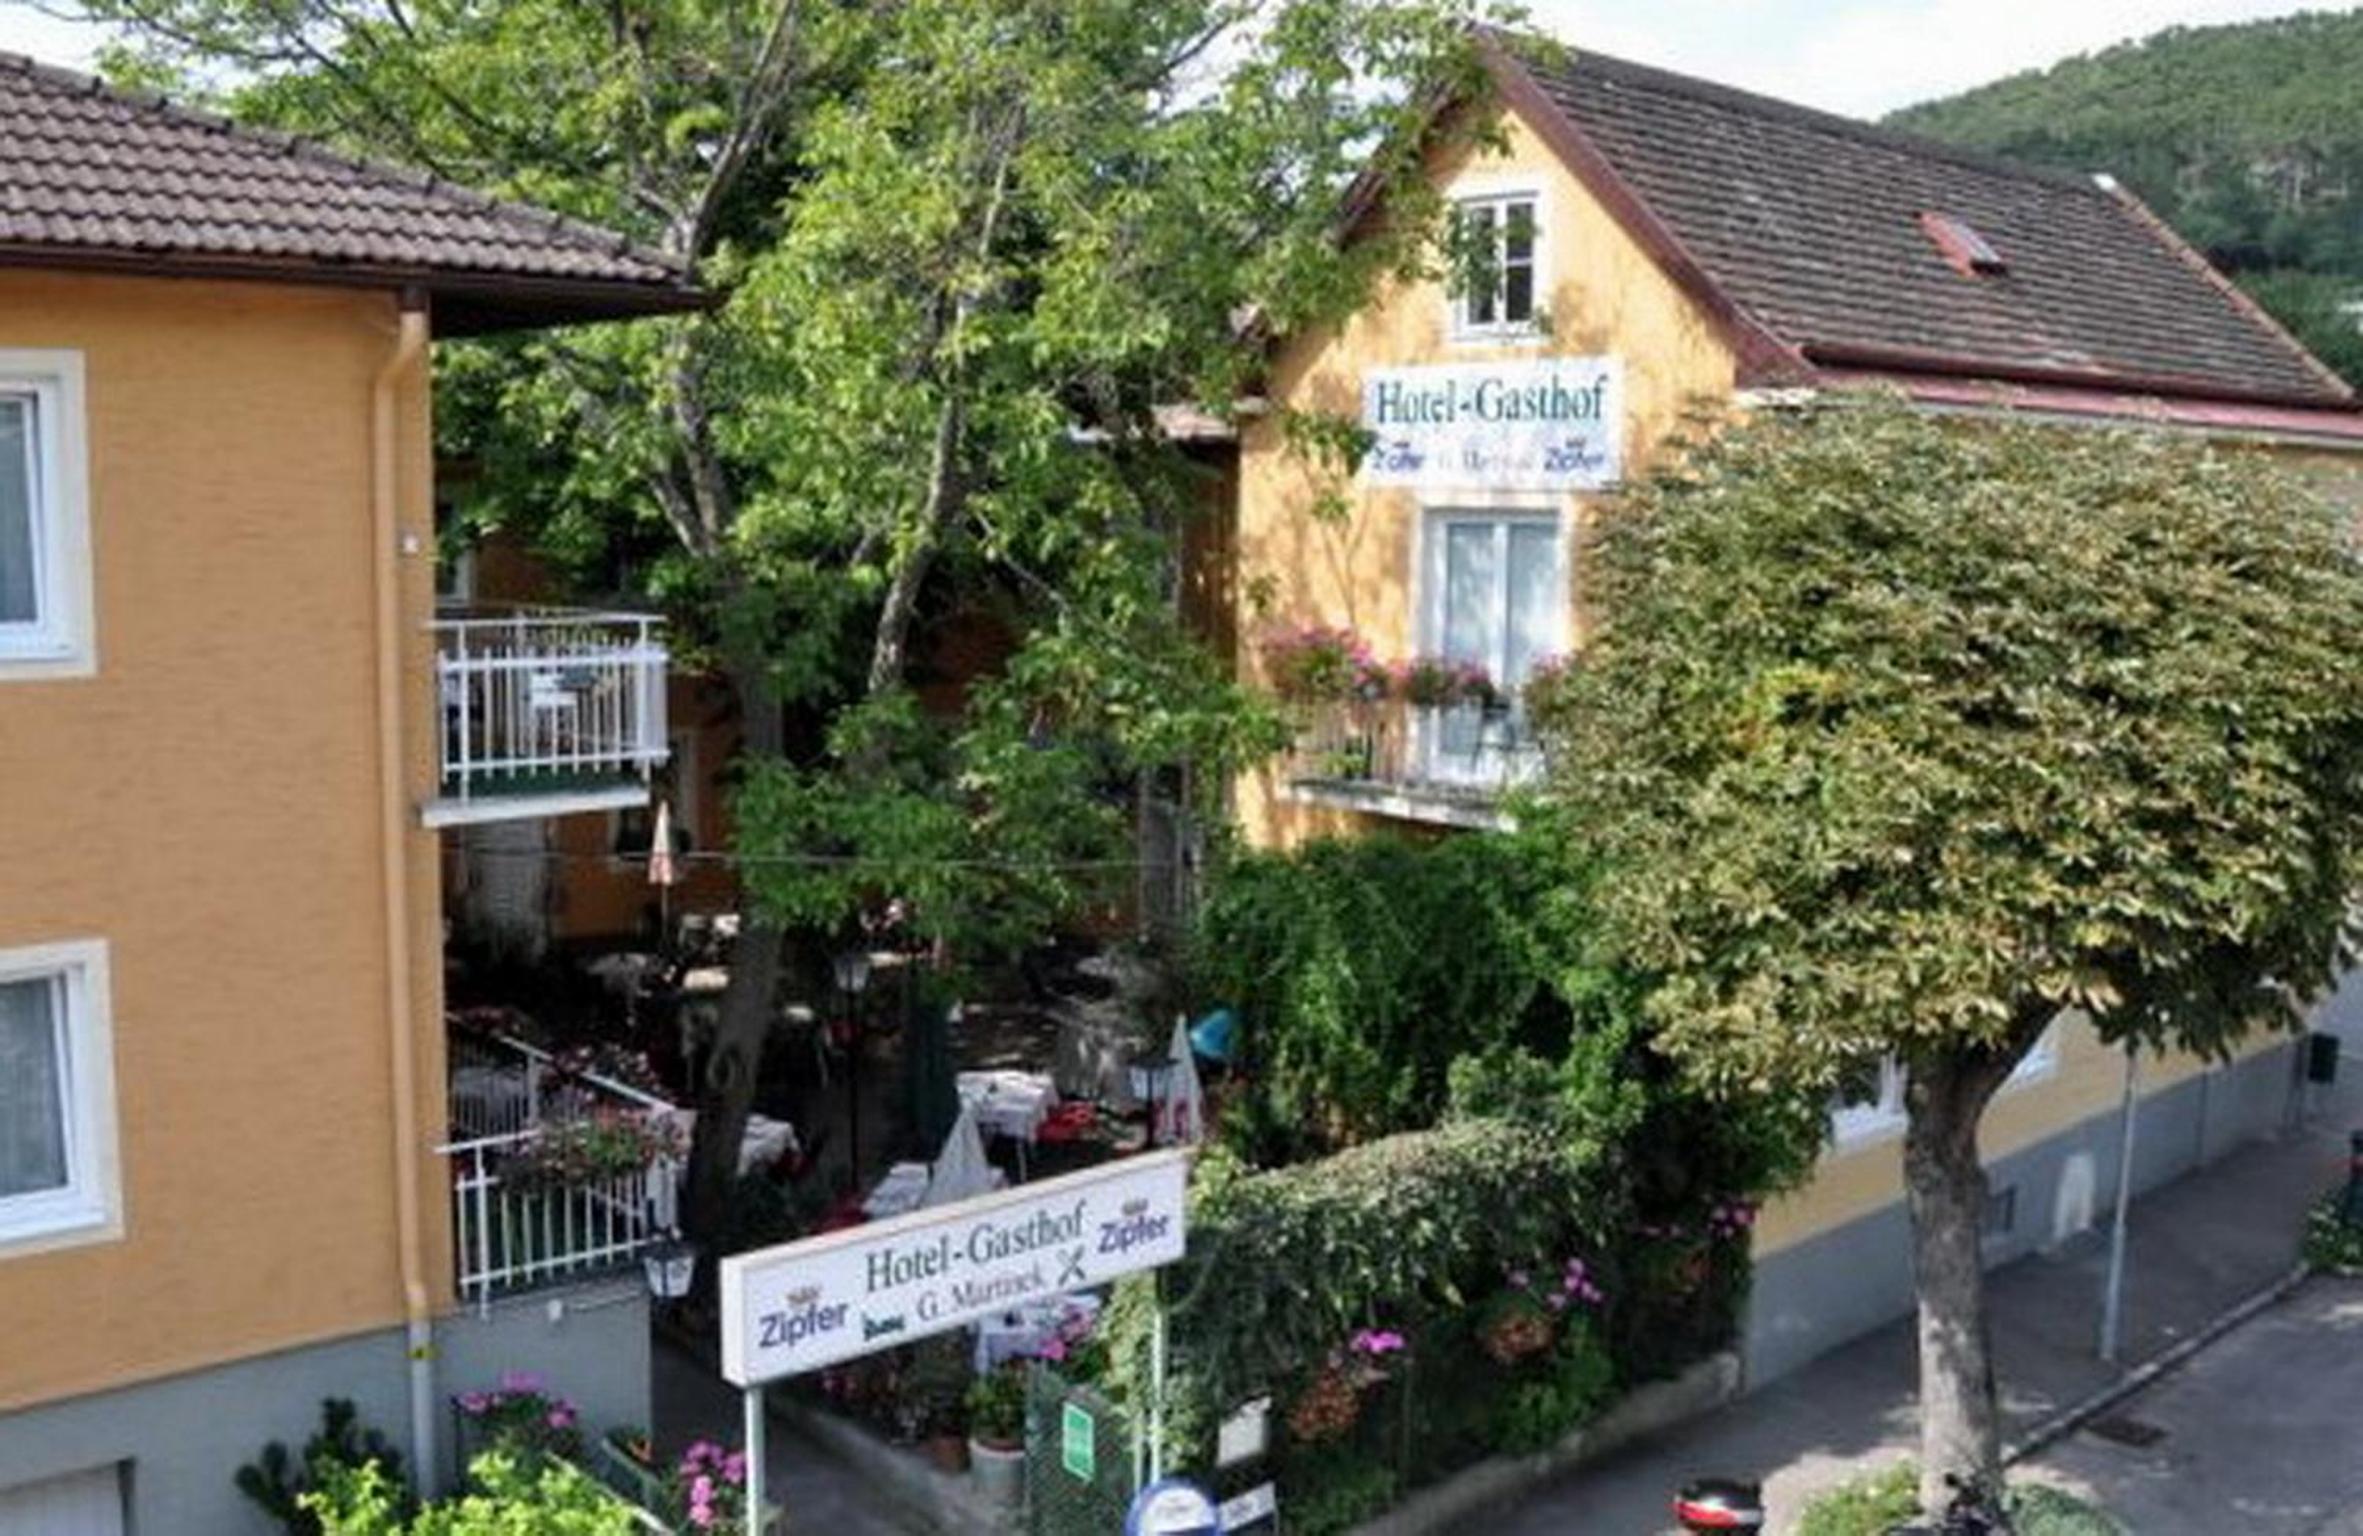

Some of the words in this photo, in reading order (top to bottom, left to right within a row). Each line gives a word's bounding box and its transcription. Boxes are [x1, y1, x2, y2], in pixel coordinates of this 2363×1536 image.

[1377, 374, 1608, 423] Hotel-Gasthof
[865, 1200, 1086, 1292] Hotel-Gasthof
[1098, 1213, 1170, 1254] Zipfer
[759, 1301, 848, 1349] Zipfer
